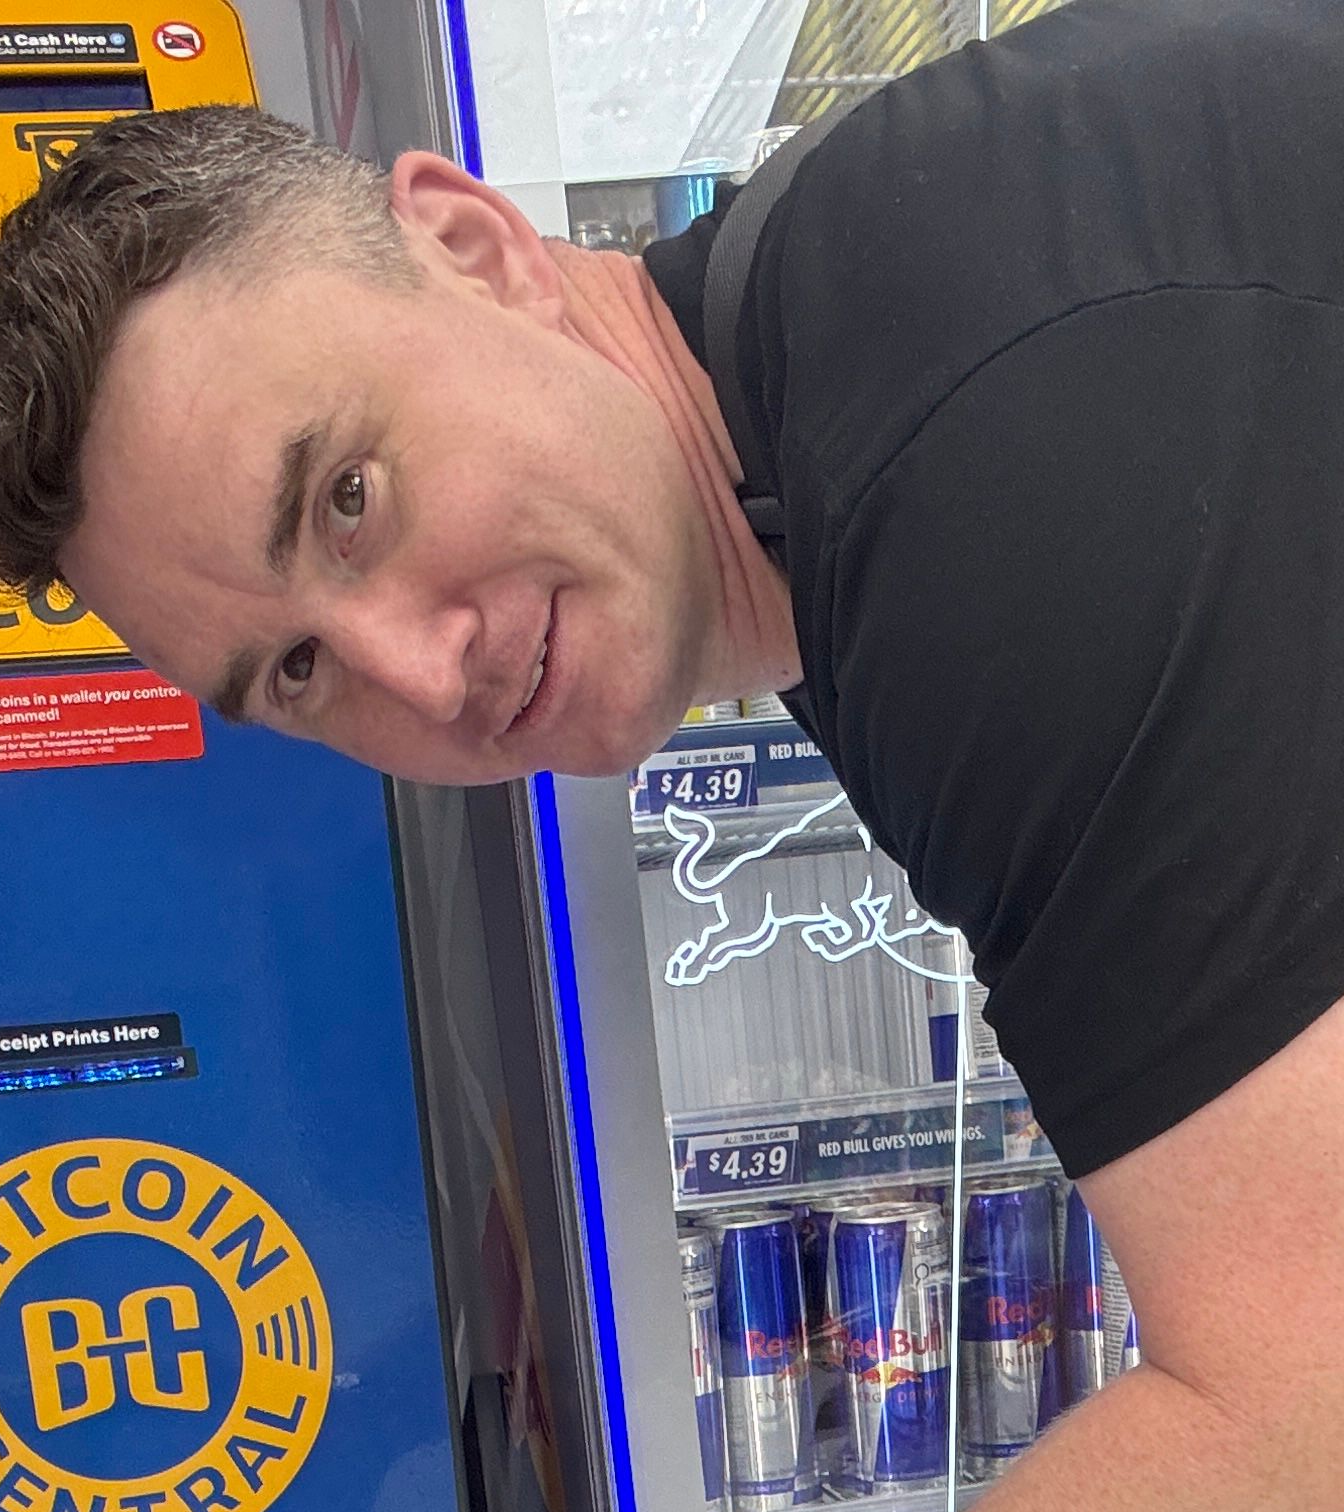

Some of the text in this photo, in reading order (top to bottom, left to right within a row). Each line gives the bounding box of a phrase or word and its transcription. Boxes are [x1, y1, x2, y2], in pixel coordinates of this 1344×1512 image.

[14, 33, 61, 46] Cash
[64, 33, 106, 46] Here
[33, 693, 47, 706] in
[49, 695, 57, 706] a
[60, 690, 102, 705] wallet
[104, 690, 131, 706] you
[769, 744, 792, 760] RED
[660, 768, 743, 803] $4.39
[52, 1028, 110, 1047] Prints
[112, 1024, 160, 1042] Here
[818, 1142, 841, 1158] RED
[844, 1139, 870, 1156] BULL
[872, 1135, 906, 1152] GIVES
[908, 1131, 941, 1148] YOU
[709, 1146, 787, 1180] $4.39
